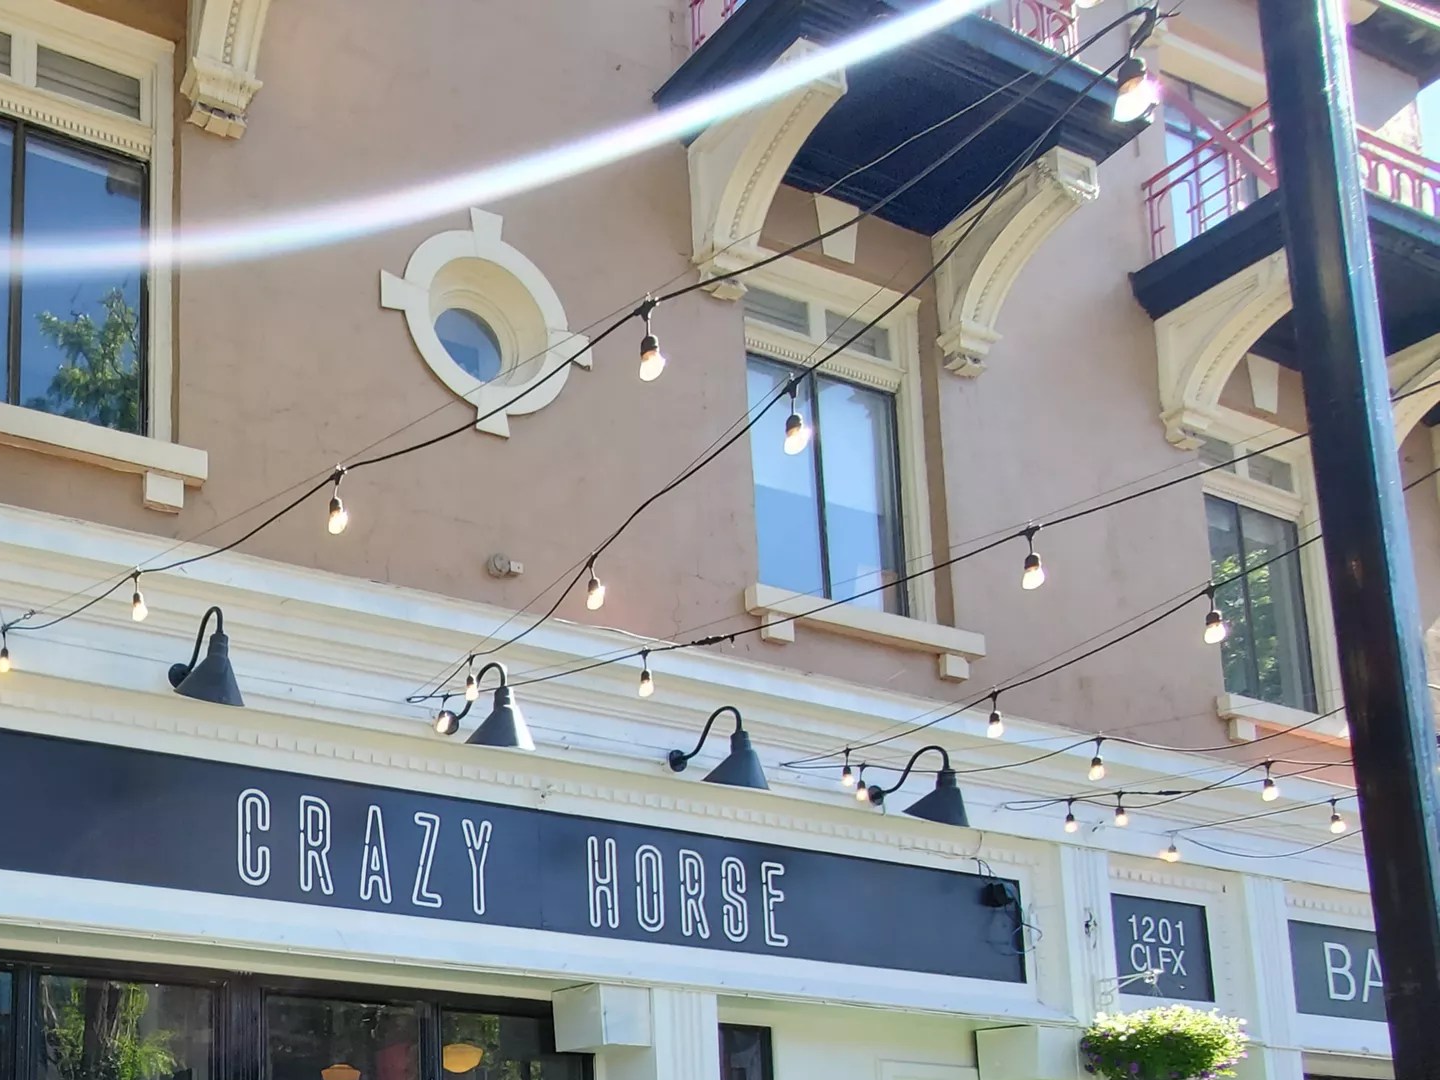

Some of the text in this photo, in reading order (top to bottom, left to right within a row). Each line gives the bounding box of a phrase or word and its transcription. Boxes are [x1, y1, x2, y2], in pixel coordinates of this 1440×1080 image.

[237, 787, 789, 948] CRAZY HORSE
[1128, 914, 1185, 946] 1201
[1130, 943, 1187, 976] CLFX
